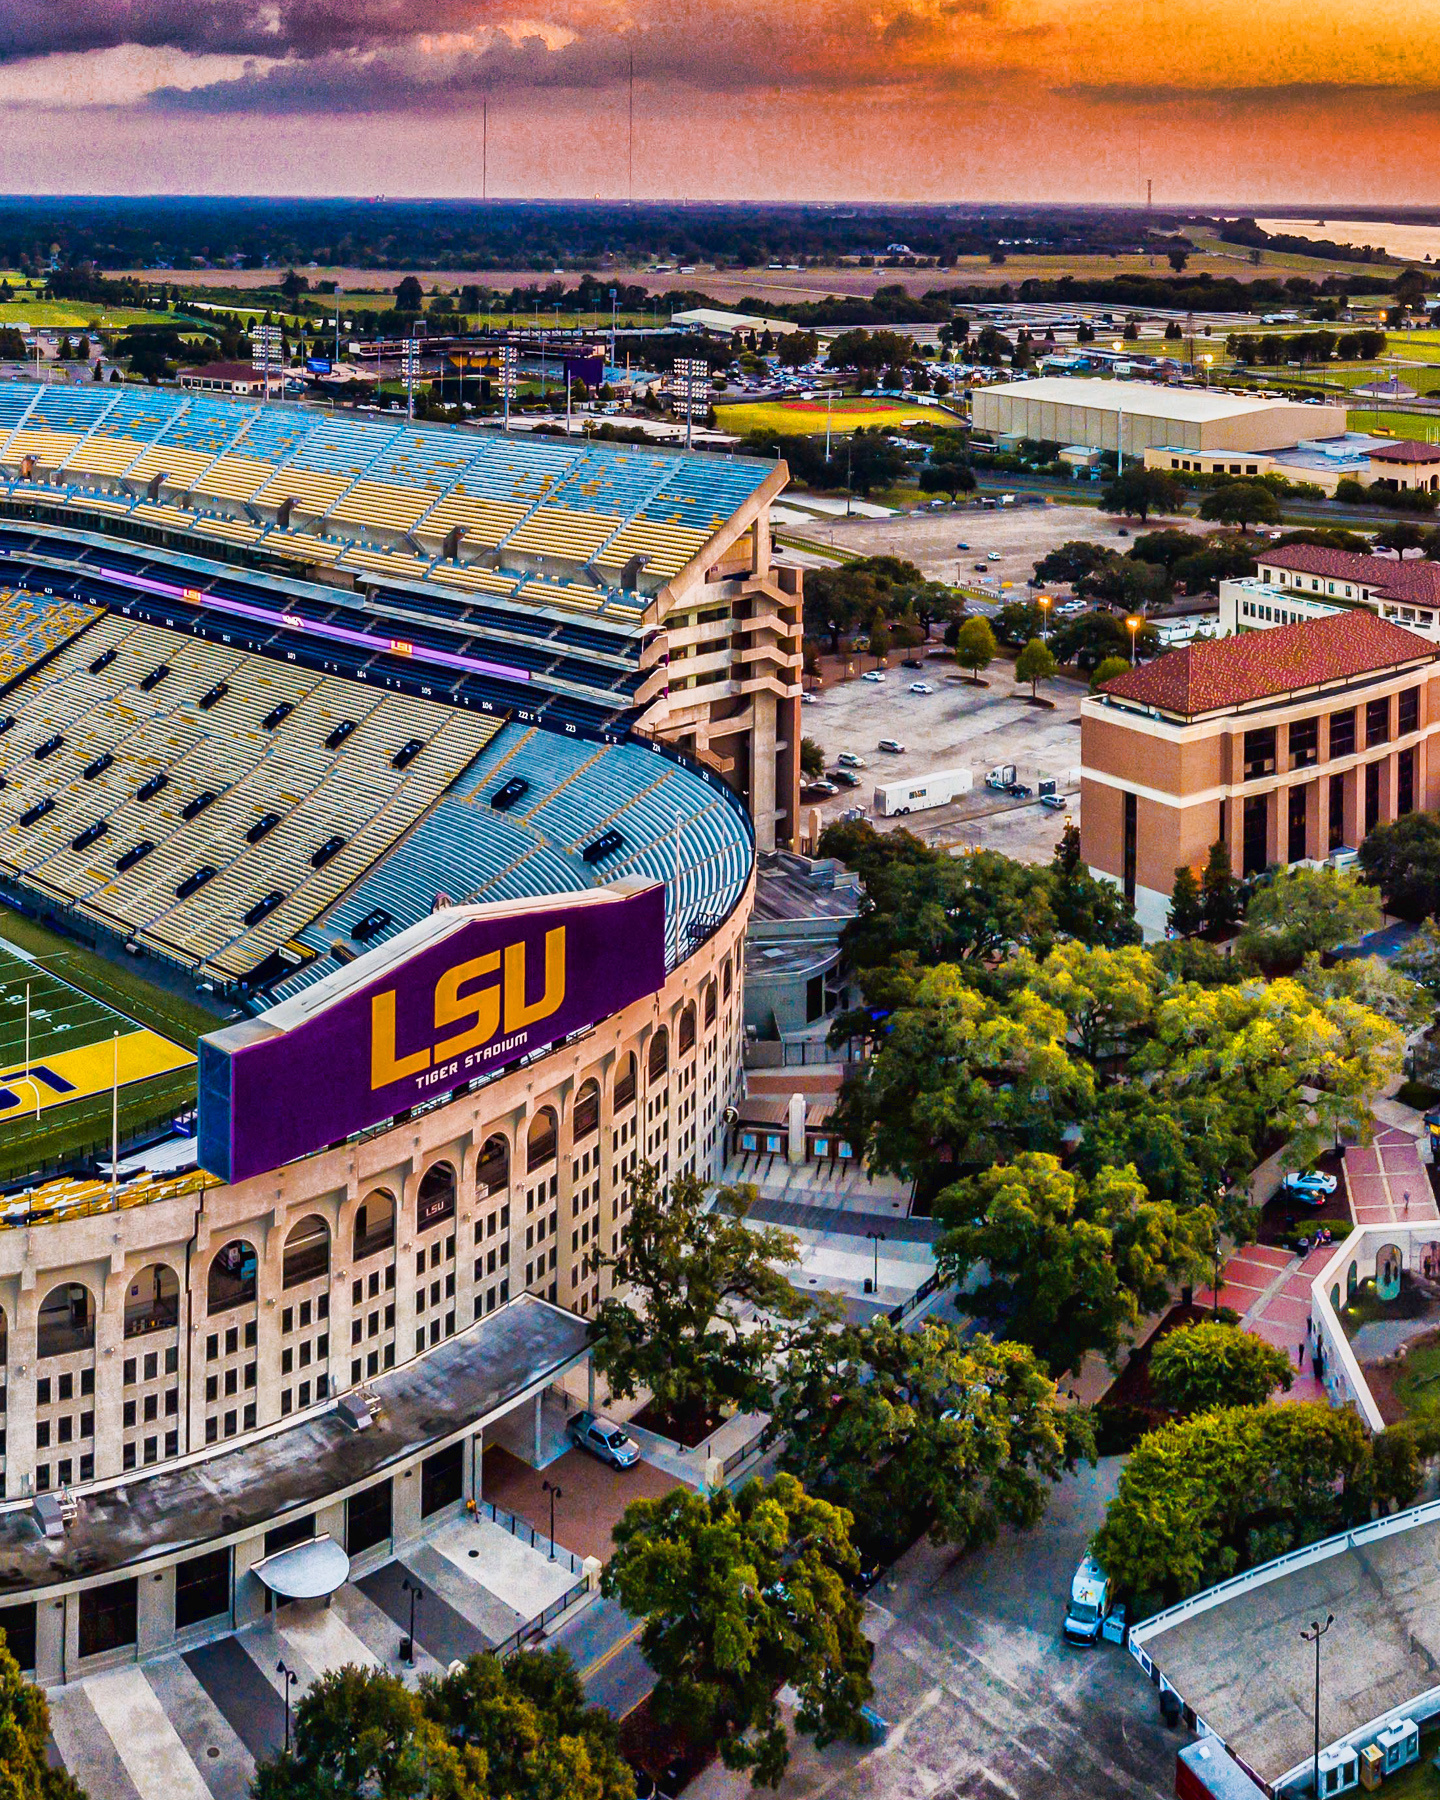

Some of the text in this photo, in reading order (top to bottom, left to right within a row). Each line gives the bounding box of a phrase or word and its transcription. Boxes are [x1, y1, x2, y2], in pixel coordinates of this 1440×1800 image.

[183, 589, 201, 602] LSU
[391, 640, 413, 653] LSU
[421, 686, 432, 695] 105
[482, 702, 493, 710] 106
[518, 710, 529, 720] 222
[565, 723, 577, 733] 223
[5, 994, 27, 1005] 15
[370, 925, 567, 1091] LSU
[29, 1009, 52, 1020] 10
[52, 1024, 71, 1032] 5
[415, 1031, 529, 1090] TIGER STADIUM
[727, 1109, 734, 1123] 7
[426, 1201, 444, 1217] LSU
